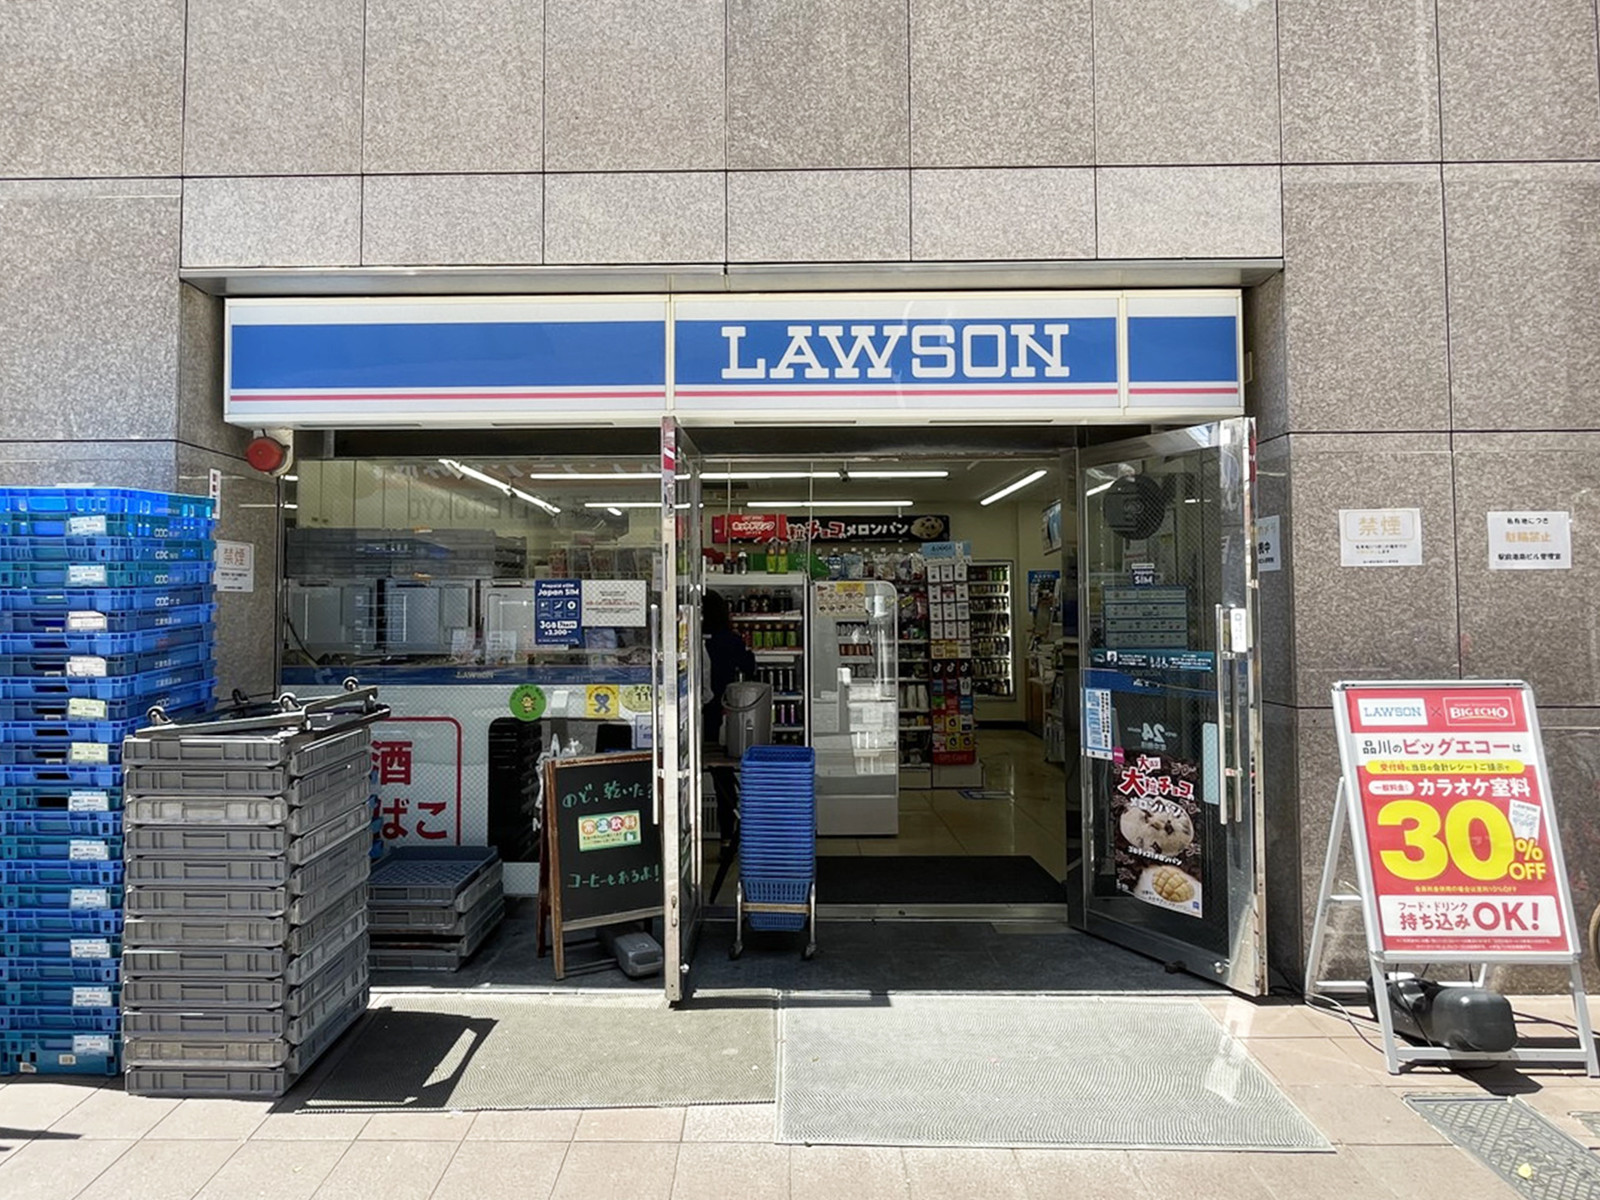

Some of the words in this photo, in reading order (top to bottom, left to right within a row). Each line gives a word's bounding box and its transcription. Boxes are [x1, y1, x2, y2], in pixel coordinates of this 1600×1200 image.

[721, 323, 1071, 380] LAWSON
[1358, 515, 1402, 536] 禁煙
[223, 547, 245, 566] 禁煙
[538, 588, 564, 597] Japan
[565, 588, 579, 596] SIM
[539, 620, 557, 629] 3GB
[635, 692, 653, 701] 11
[1363, 706, 1422, 718] LAWSON
[1449, 706, 1475, 719] BIG
[1475, 706, 1509, 719] ECHO
[1362, 738, 1522, 756] 品川のビッグエコーは
[370, 740, 413, 785] 酒
[1418, 777, 1531, 797] カラオケ室料
[1508, 862, 1547, 881] OFF
[1397, 901, 1469, 912] フード・ドリンク
[1399, 912, 1471, 931] 持ち込み
[1472, 901, 1540, 931] OK!
